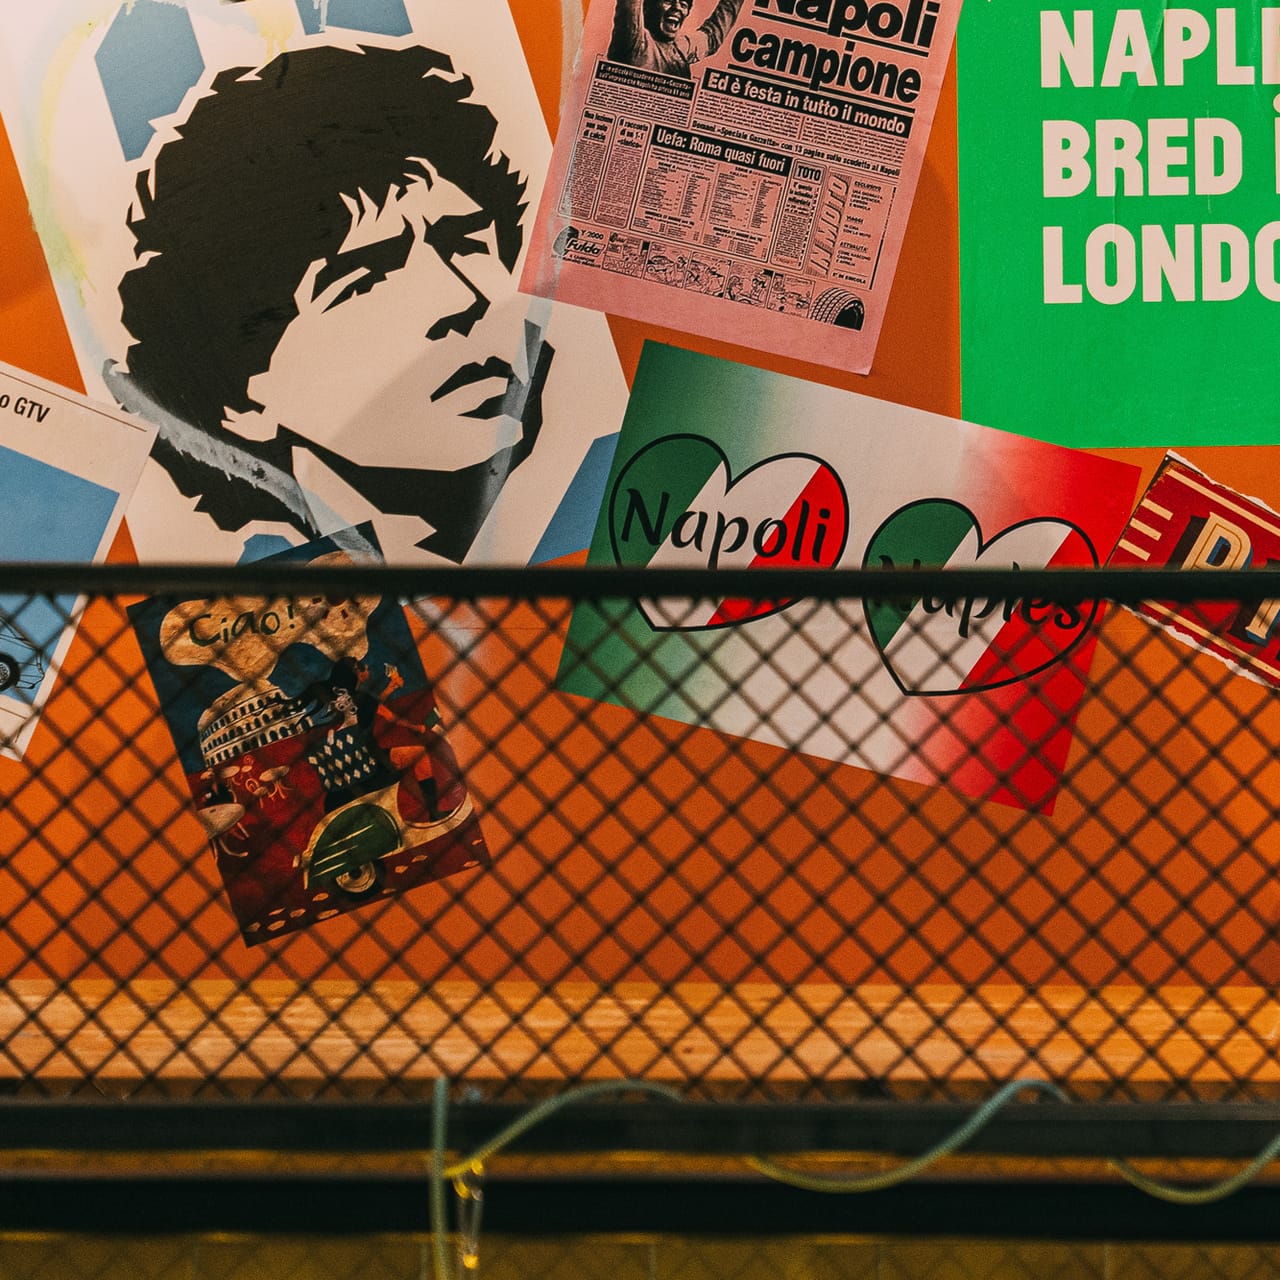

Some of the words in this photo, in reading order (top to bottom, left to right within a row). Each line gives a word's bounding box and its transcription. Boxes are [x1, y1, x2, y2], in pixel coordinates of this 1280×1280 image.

[731, 27, 922, 104] campione
[707, 71, 729, 92] Ed
[730, 76, 741, 95] è
[743, 80, 782, 104] festa
[784, 90, 800, 109] in
[802, 95, 839, 118] tutto
[841, 103, 853, 121] il
[855, 110, 906, 134] mondo
[656, 128, 688, 149] Uefa:
[690, 141, 721, 158] Roma
[724, 147, 756, 165] quasi
[758, 153, 786, 172] fuori
[1042, 117, 1243, 198] BRED
[14, 396, 51, 423] GTV
[620, 486, 831, 571] Napoli
[188, 603, 296, 648] Ciao!
